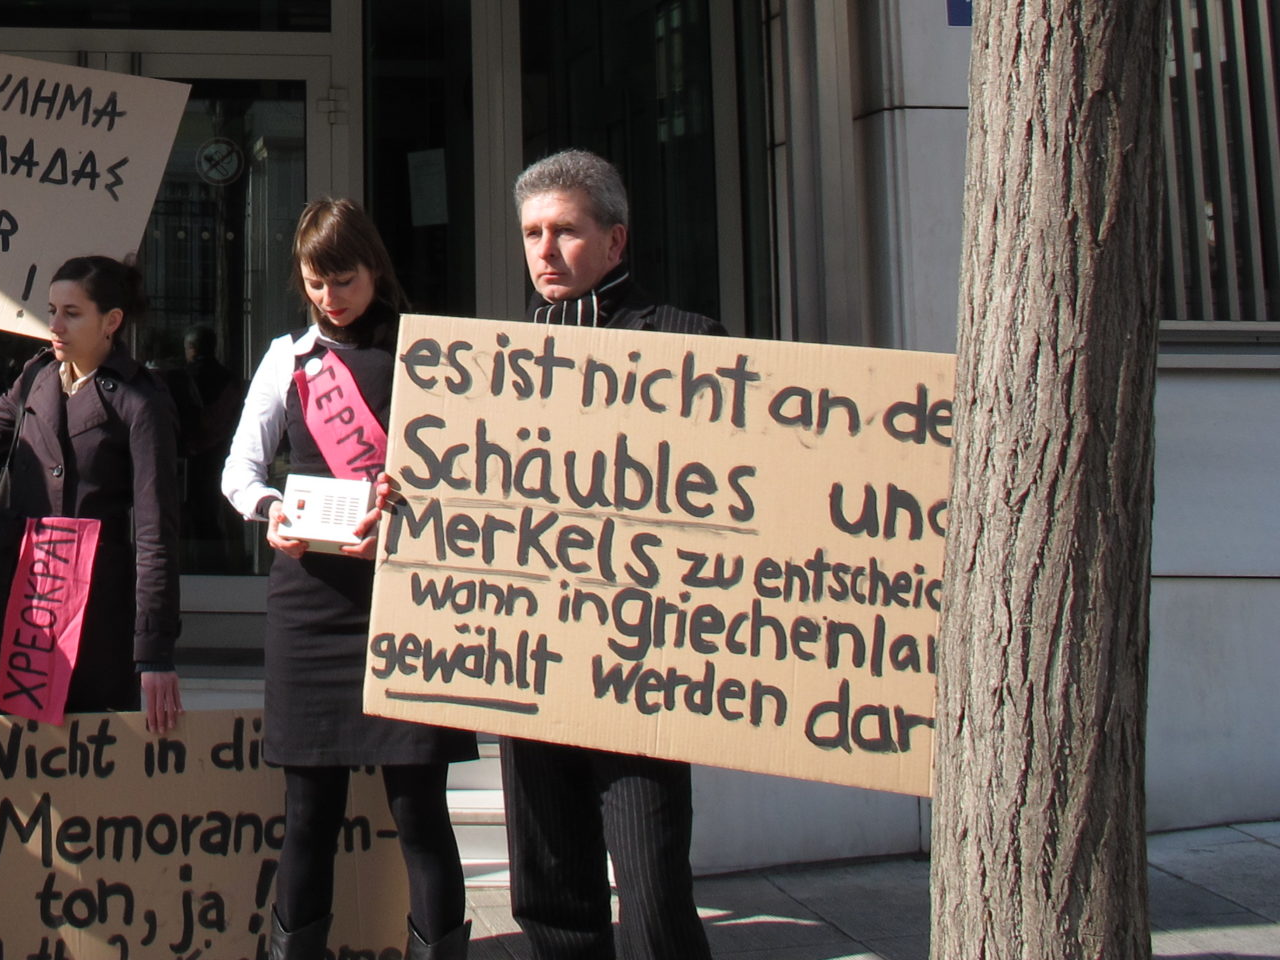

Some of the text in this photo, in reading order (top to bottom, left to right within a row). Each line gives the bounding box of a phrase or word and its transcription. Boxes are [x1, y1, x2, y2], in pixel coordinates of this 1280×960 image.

[400, 336, 473, 395] es
[491, 332, 575, 400] ist
[581, 350, 760, 429] nicht
[767, 384, 861, 436] an
[399, 414, 757, 523] Schäubles
[384, 495, 662, 589] Merkels
[676, 546, 744, 592] zu
[370, 623, 936, 754] gewählt werden dar
[144, 732, 186, 778] in
[35, 871, 158, 946] ton,
